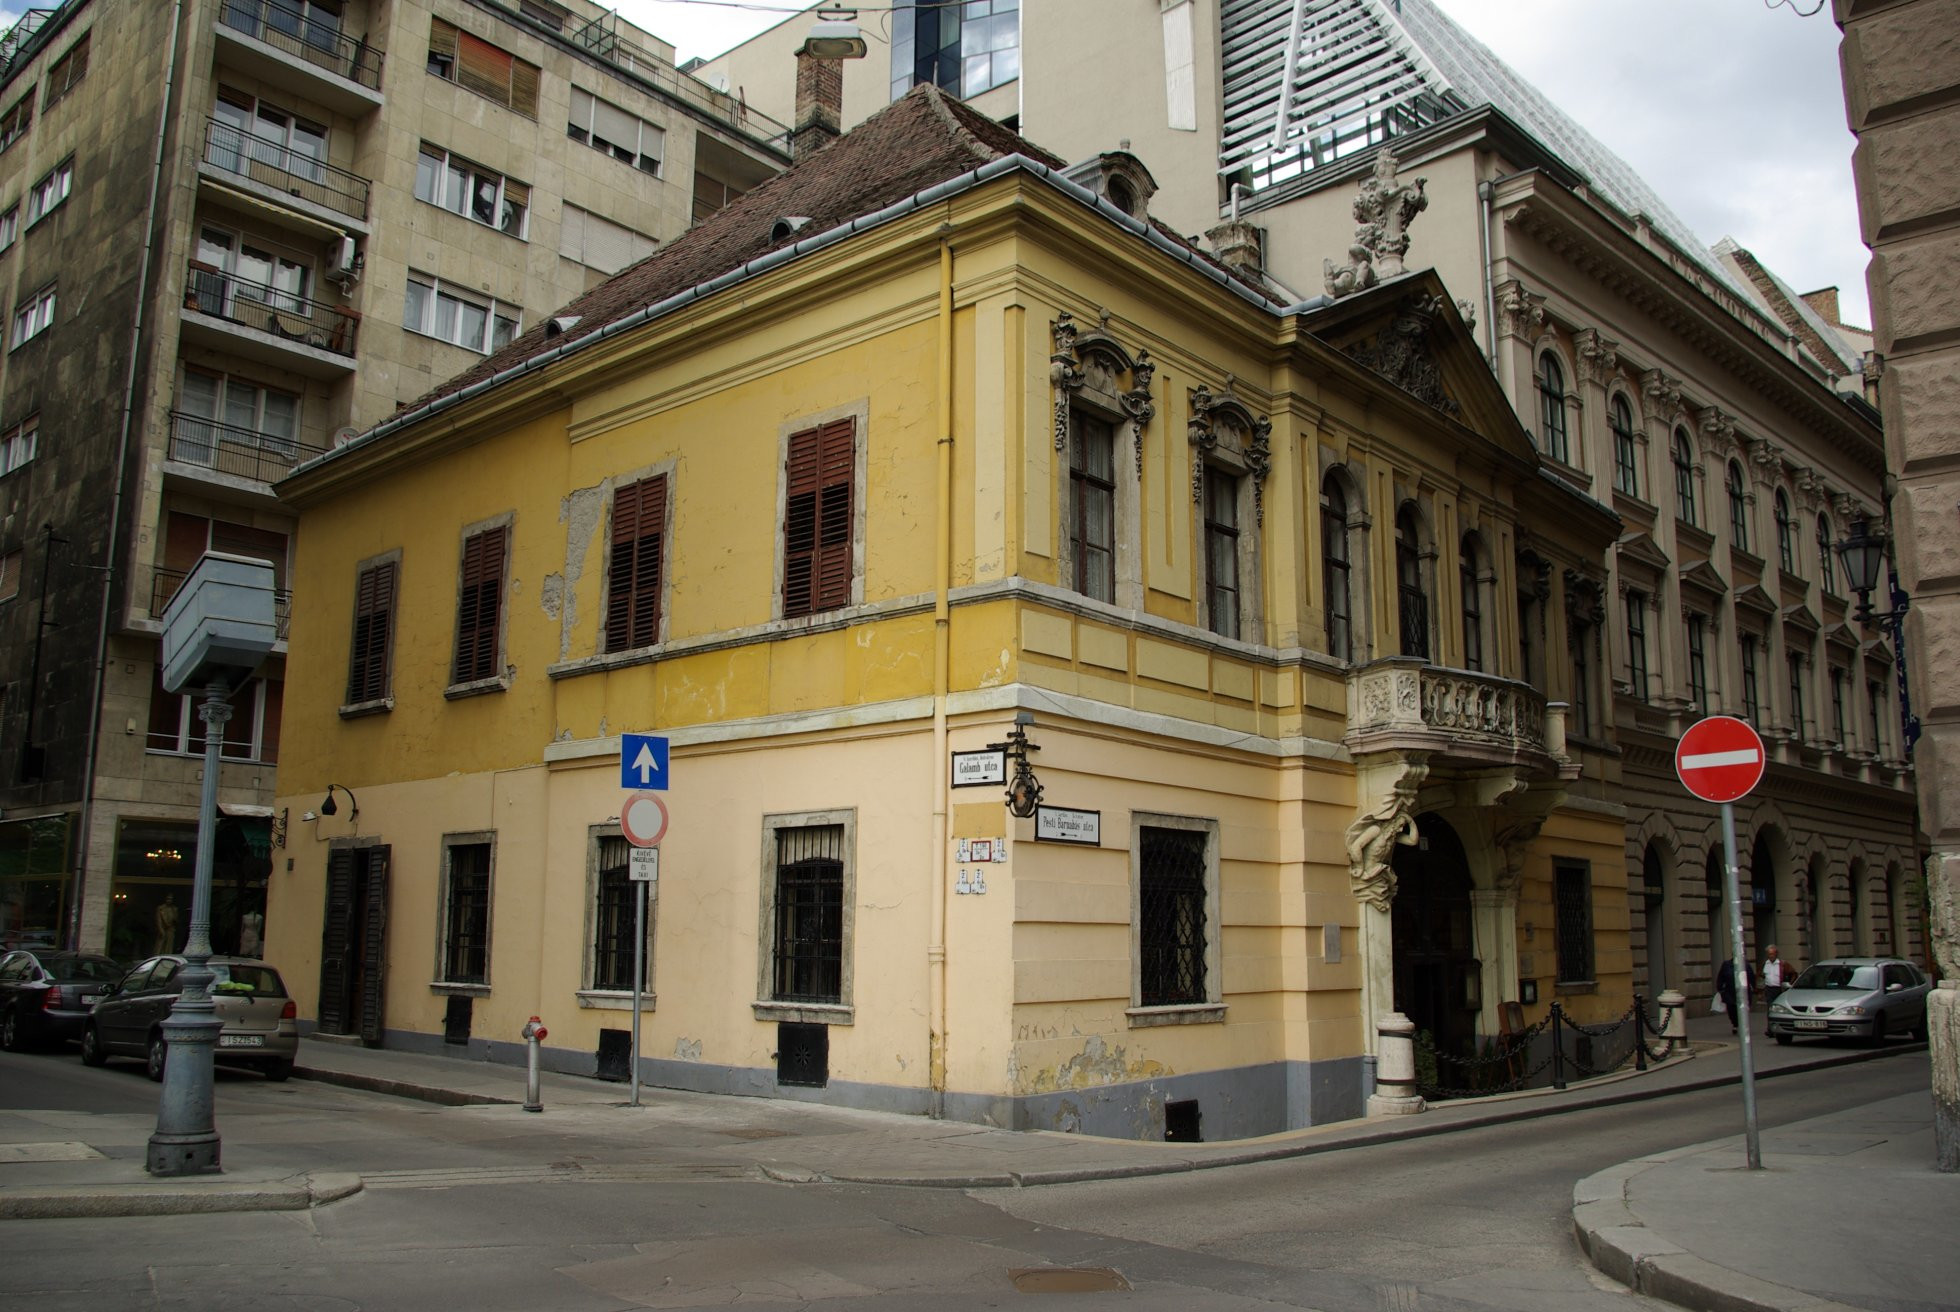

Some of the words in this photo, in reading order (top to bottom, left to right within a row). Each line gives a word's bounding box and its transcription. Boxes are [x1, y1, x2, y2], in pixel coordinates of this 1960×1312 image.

[959, 761, 980, 773] Galamb
[984, 760, 998, 772] utca
[1043, 815, 1056, 828] Pesti
[1083, 821, 1094, 832] utca
